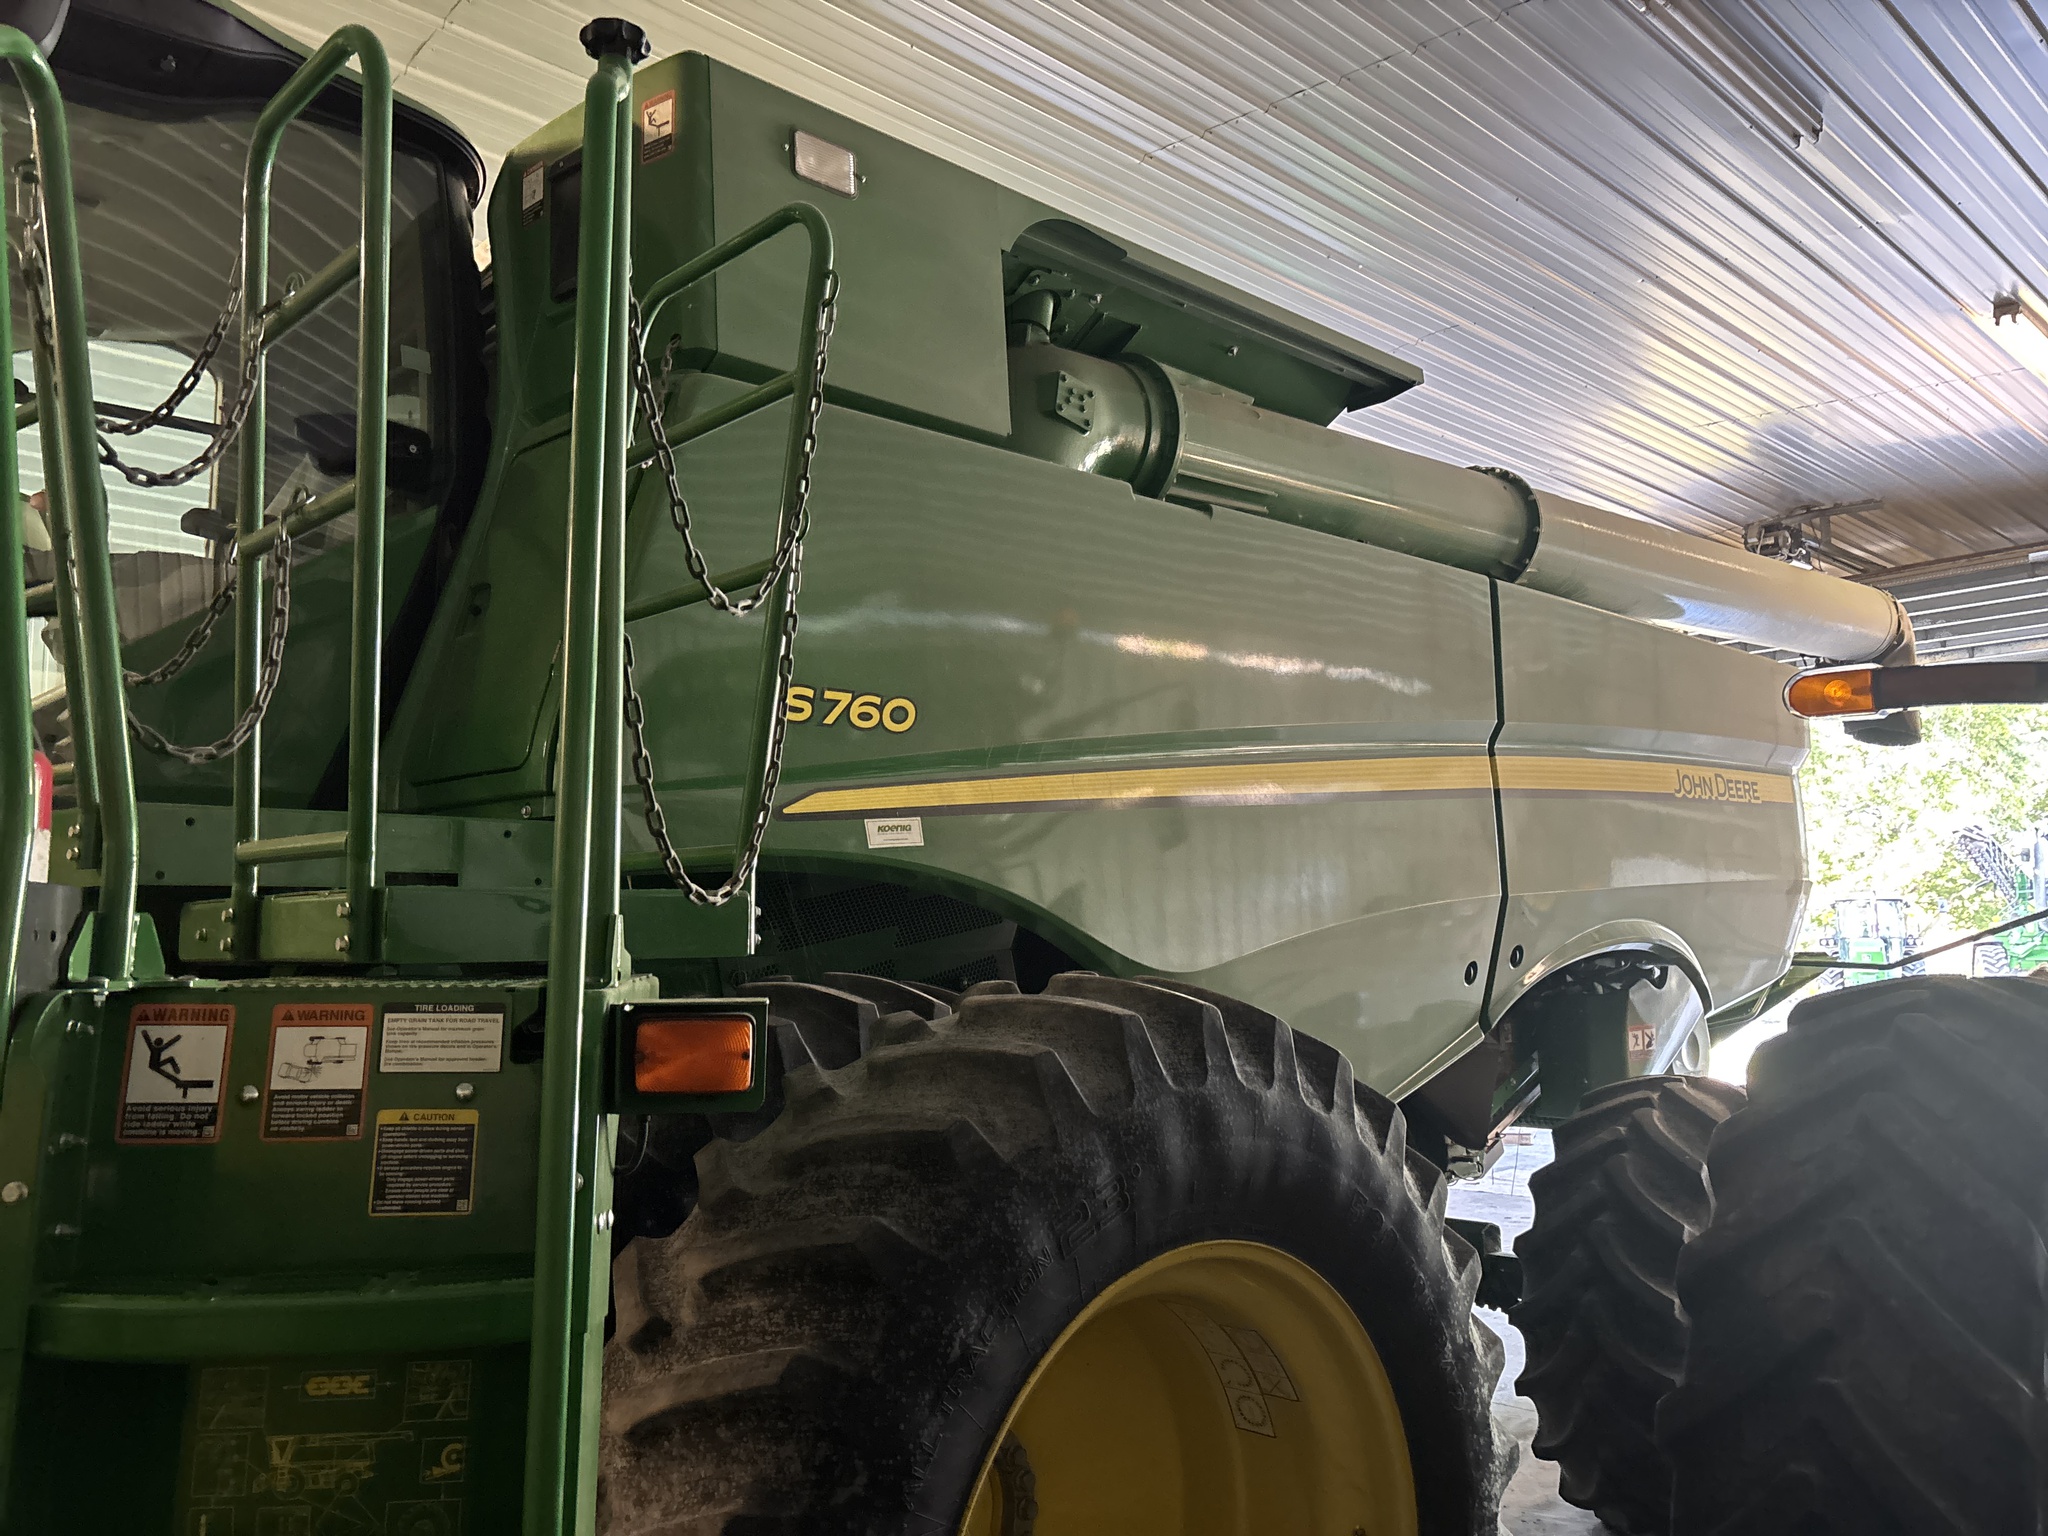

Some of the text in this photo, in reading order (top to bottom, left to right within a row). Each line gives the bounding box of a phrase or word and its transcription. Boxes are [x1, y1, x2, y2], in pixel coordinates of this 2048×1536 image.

[821, 688, 917, 733] 760
[1674, 769, 1762, 803] JOHN DEERE
[152, 1007, 230, 1022] WARNING
[414, 1004, 475, 1012] TIRE LOADING
[296, 1009, 365, 1021] WARNING
[413, 1113, 456, 1121] CAUTION
